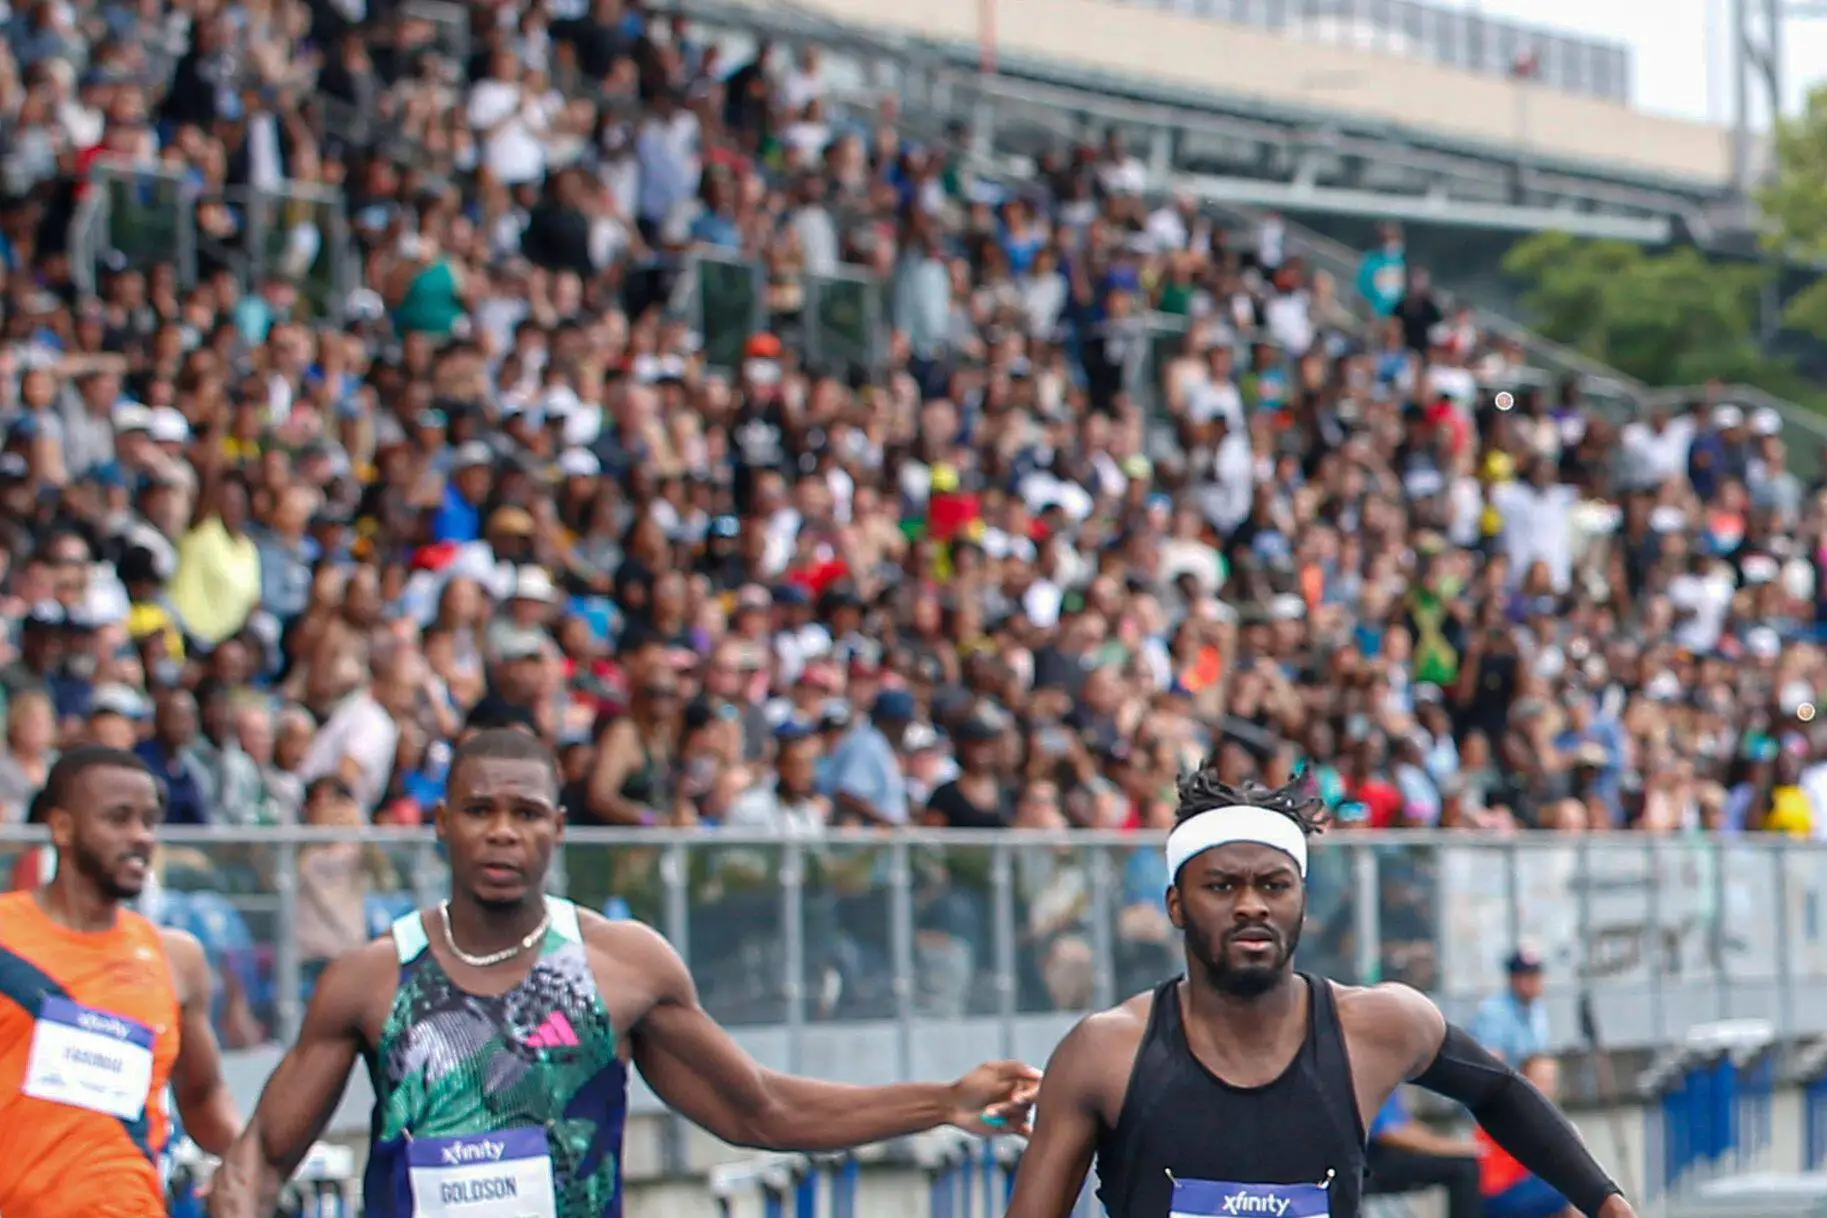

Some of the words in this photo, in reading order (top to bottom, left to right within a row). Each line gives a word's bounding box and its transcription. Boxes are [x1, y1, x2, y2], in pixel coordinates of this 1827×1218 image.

[441, 1139, 505, 1165] xfinity
[441, 1176, 518, 1204] GOLDSON
[1222, 1191, 1290, 1216] xfinity
